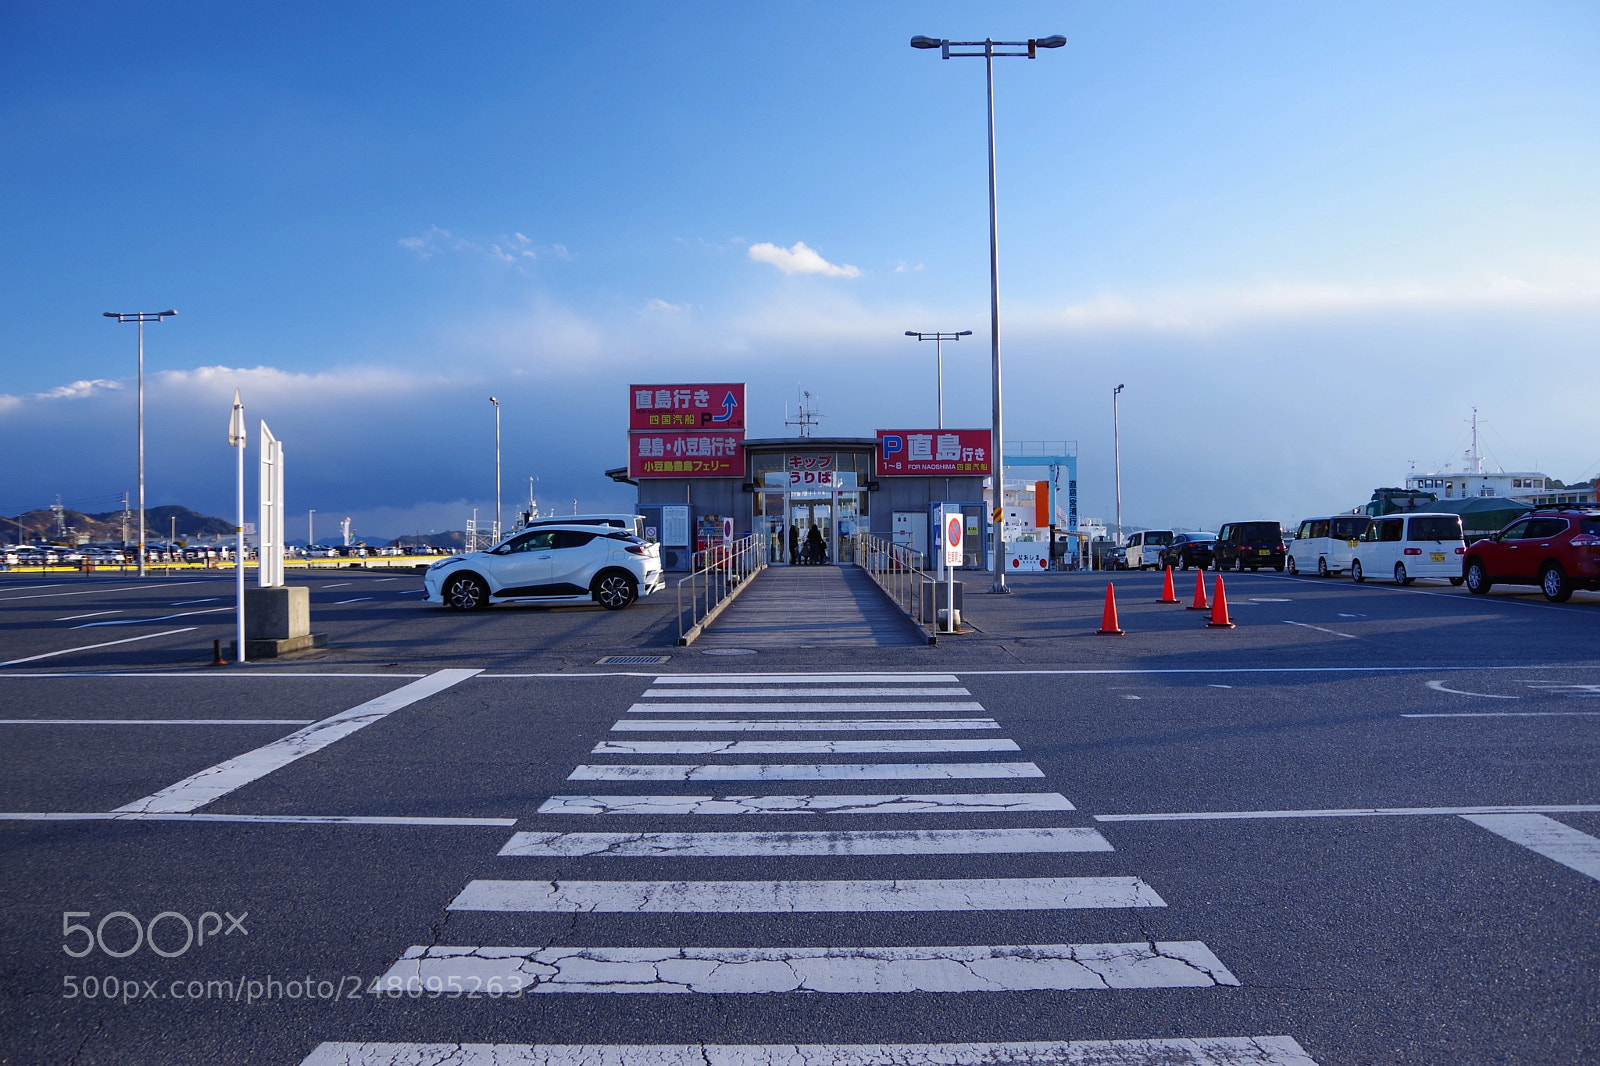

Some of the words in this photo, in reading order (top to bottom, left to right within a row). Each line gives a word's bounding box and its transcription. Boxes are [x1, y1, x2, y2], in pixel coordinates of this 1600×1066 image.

[635, 389, 710, 409] 直島行き
[649, 414, 695, 425] 四国汽船
[701, 413, 712, 426] P
[638, 437, 737, 456] 豊島・小豆島行き
[882, 435, 903, 460] P
[644, 461, 729, 472] 小豆島豊島フェリー
[788, 455, 832, 468] キップ
[790, 471, 832, 484] うりば
